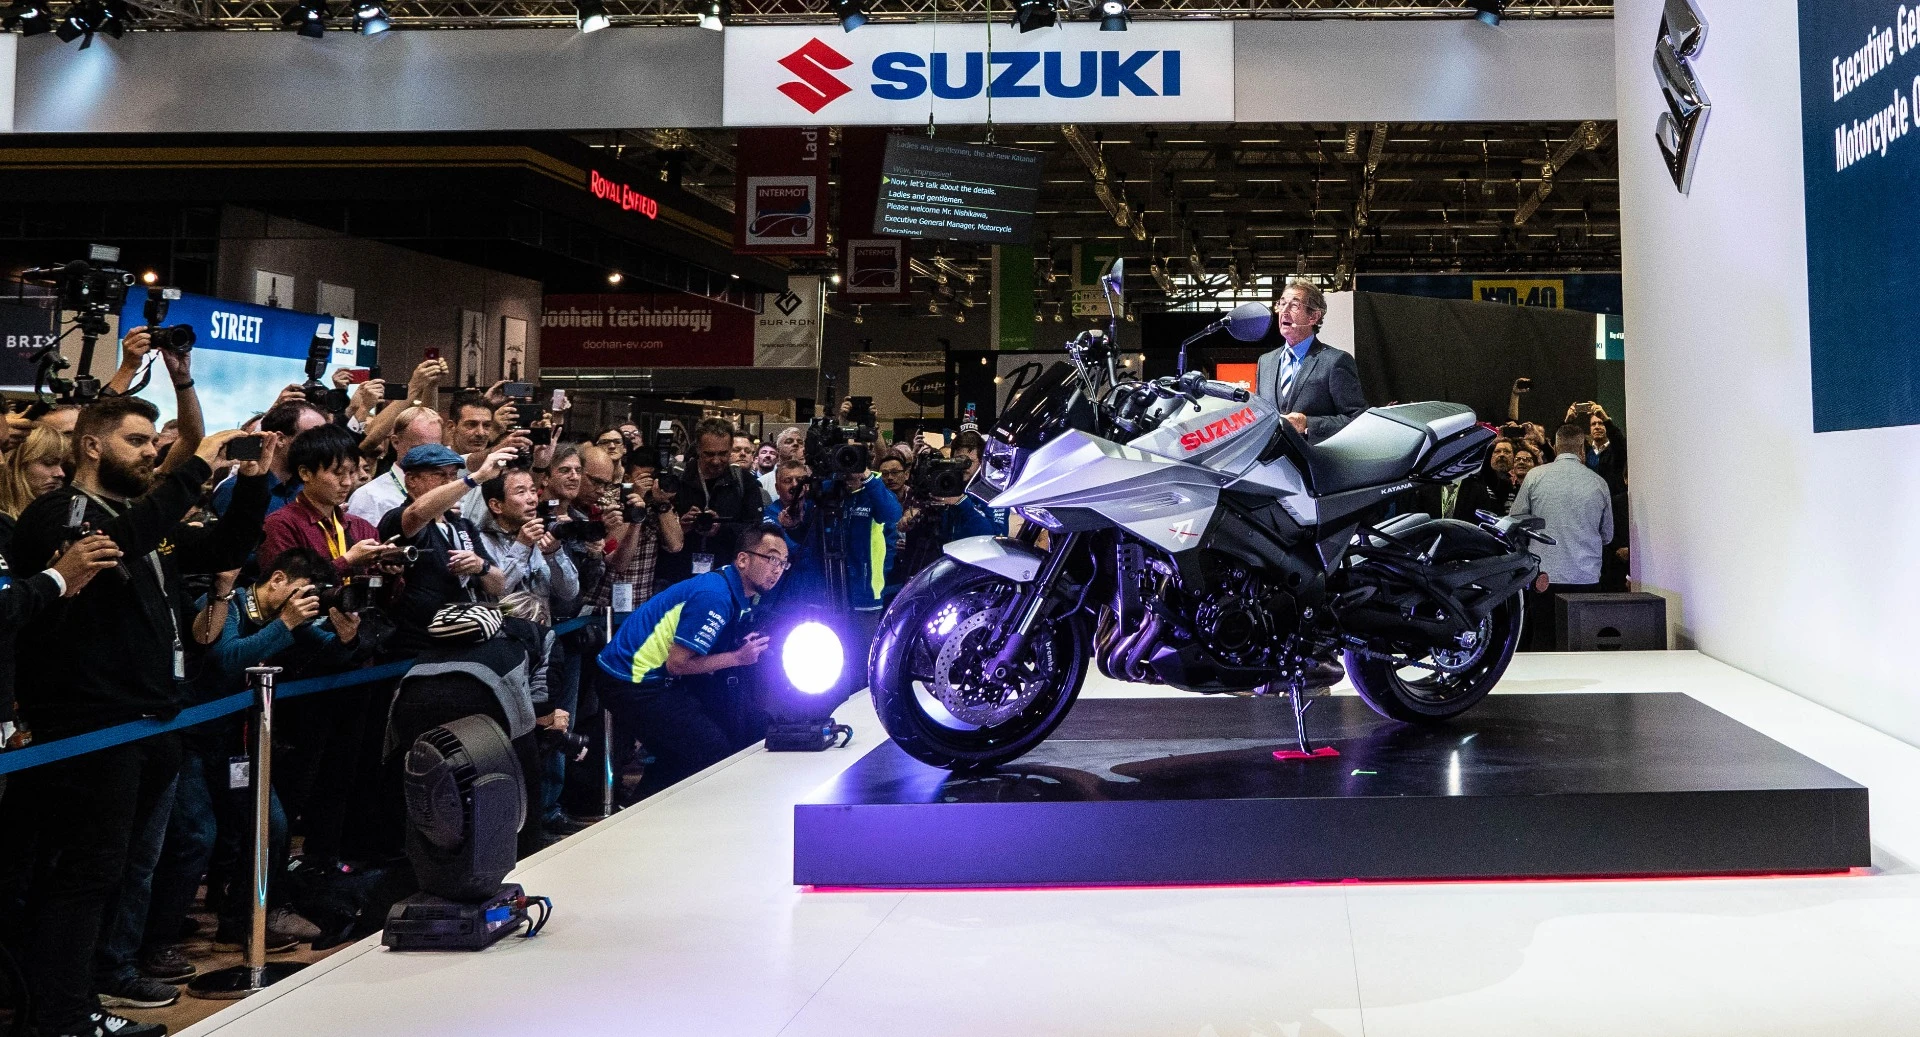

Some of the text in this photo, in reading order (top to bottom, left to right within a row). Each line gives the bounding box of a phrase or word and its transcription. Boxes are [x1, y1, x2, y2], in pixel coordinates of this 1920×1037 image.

[1832, 26, 1893, 102] Executive
[871, 50, 1180, 100] SUZUKI
[1835, 88, 1908, 172] Motorcycle
[591, 170, 657, 219] ROYAL ENFIELD
[759, 188, 806, 198] INTERMOT
[890, 177, 908, 187] Now,
[925, 181, 938, 189] talk
[939, 183, 959, 191] about
[960, 184, 972, 192] the
[973, 186, 997, 196] details.
[888, 190, 910, 199] Ladies
[926, 194, 964, 205] gentlemen.
[886, 202, 989, 220] Please welcome Mr. Nishikawa,
[885, 215, 1012, 234] Executive General Manager, Motorcycle
[856, 249, 893, 257] INTERMOT
[210, 310, 263, 344] STREET
[609, 306, 712, 332] technology
[759, 318, 815, 327] SUR-RON
[583, 339, 663, 350] doohan-ev.com
[1180, 407, 1256, 451] SUZUKI
[1381, 482, 1413, 495] KATANA
[1045, 640, 1054, 672] brembo
